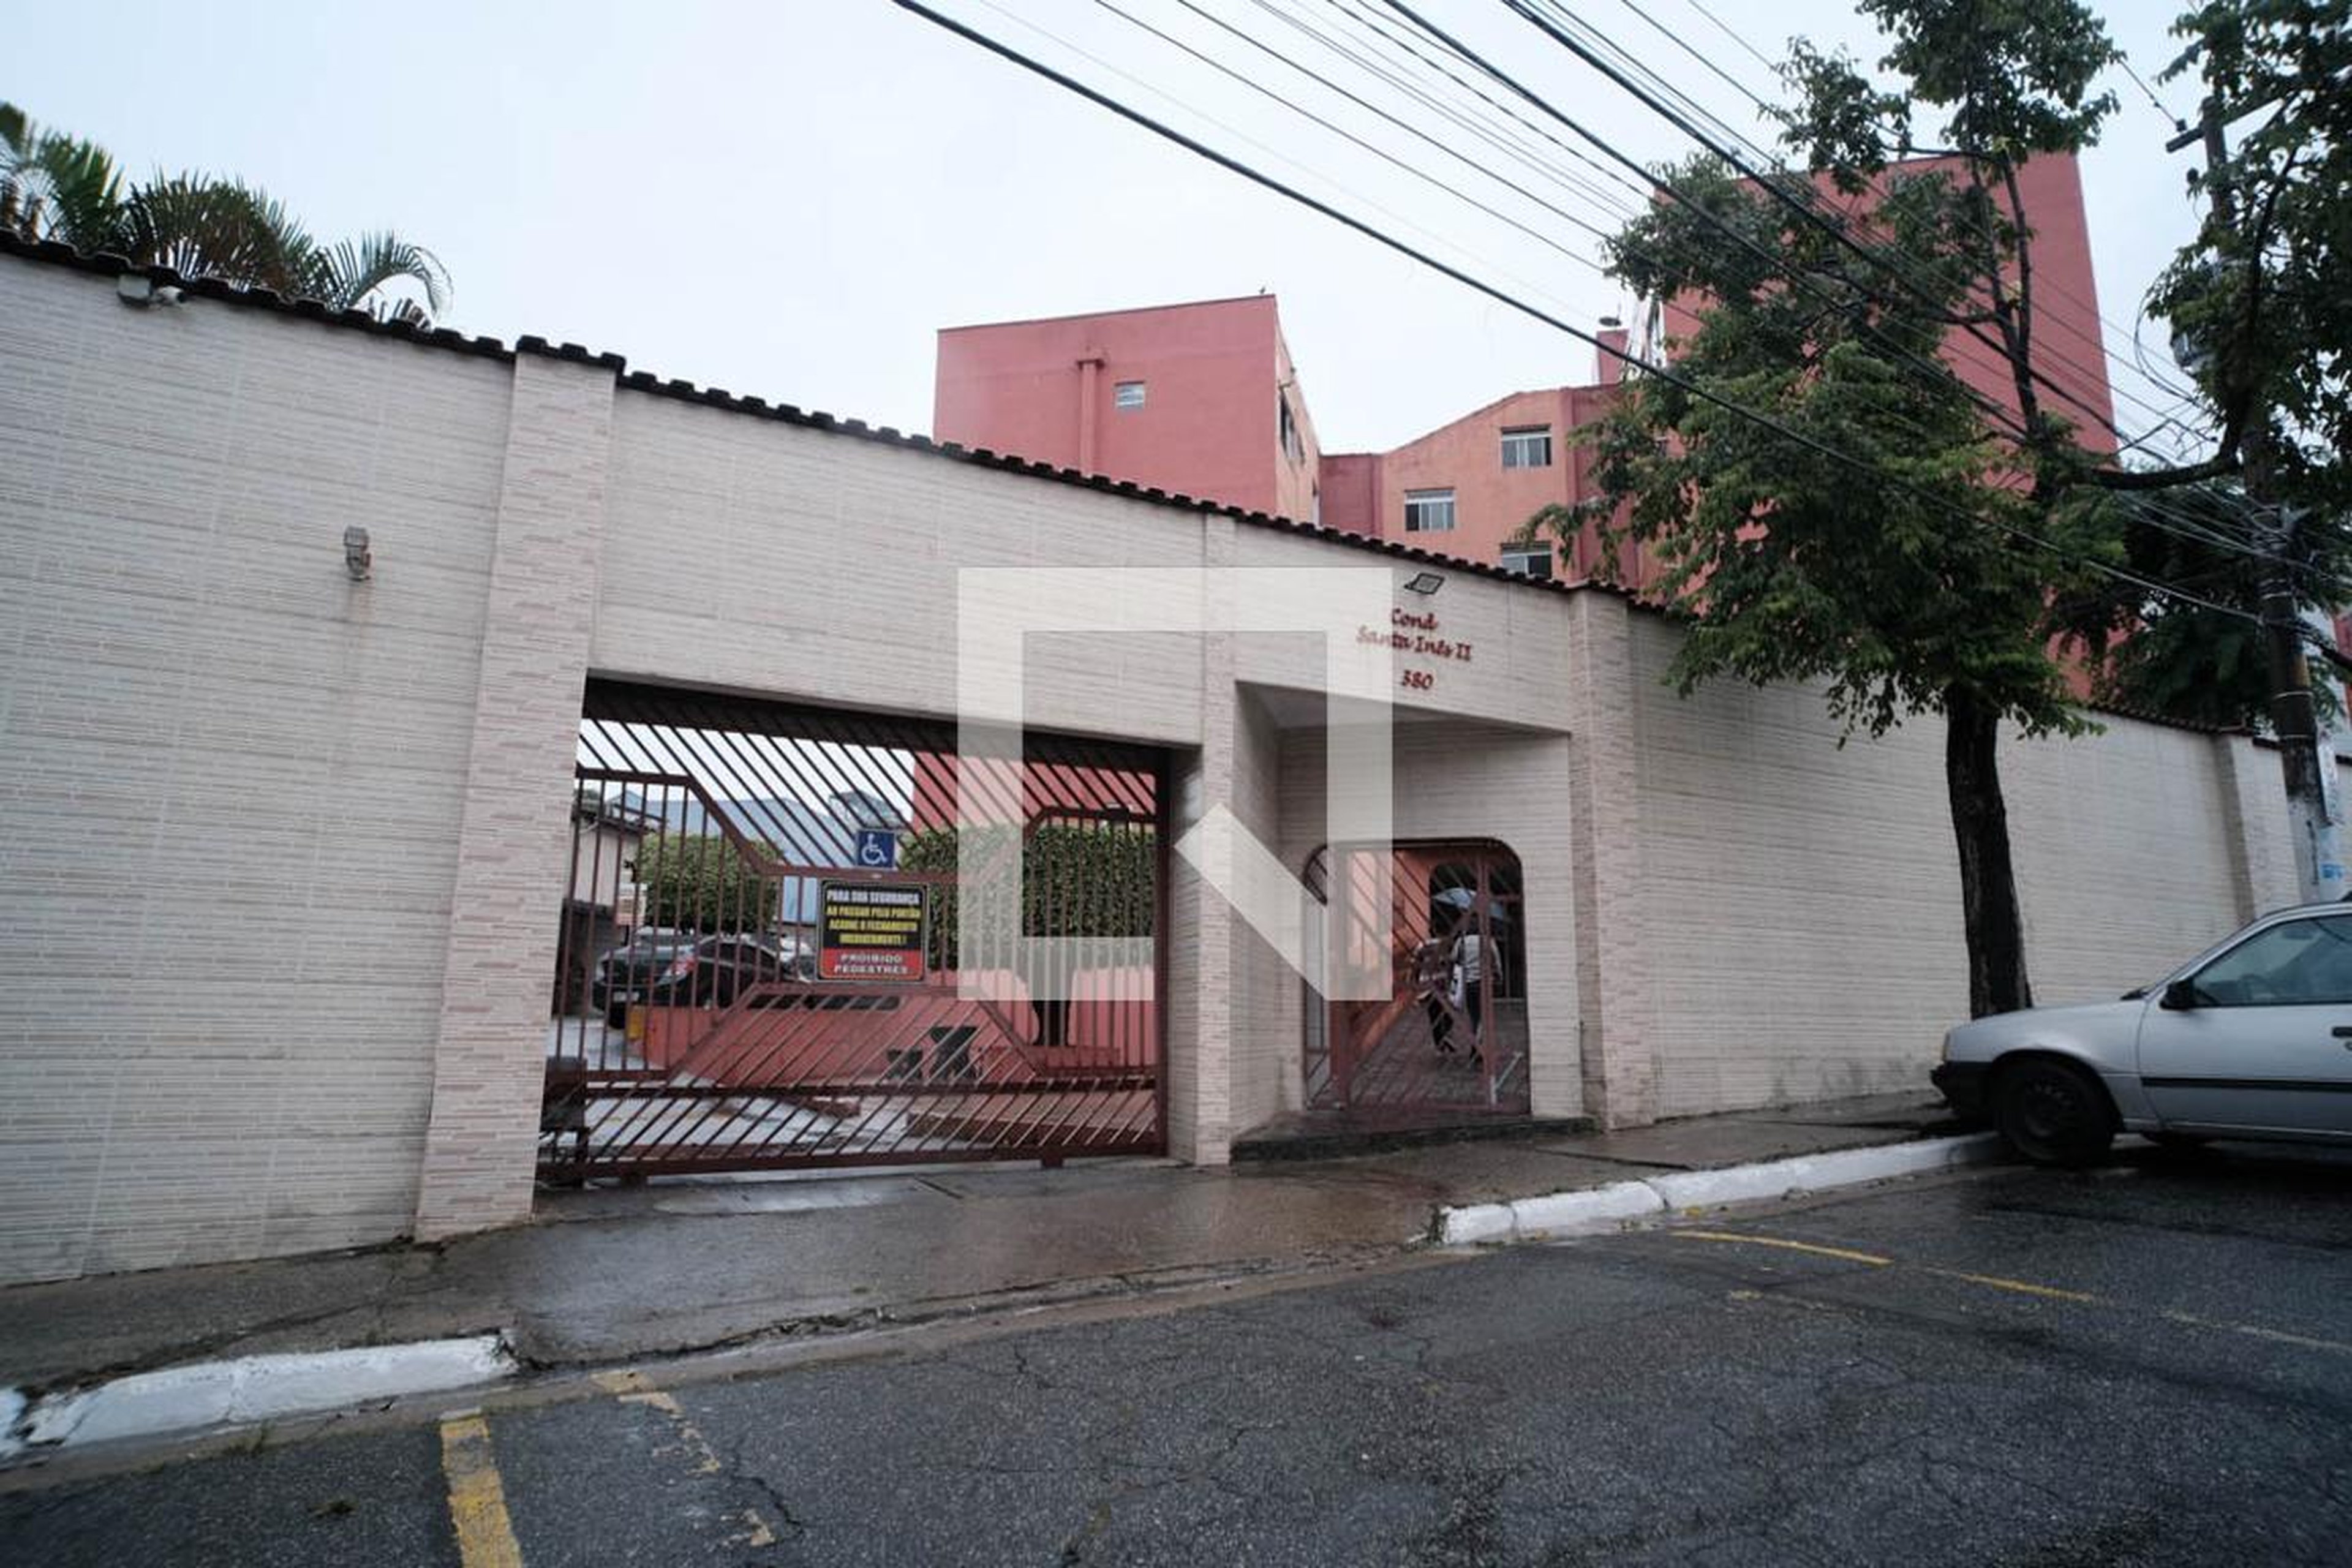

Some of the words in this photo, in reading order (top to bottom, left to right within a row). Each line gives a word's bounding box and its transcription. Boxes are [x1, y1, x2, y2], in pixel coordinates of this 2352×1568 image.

[1355, 625, 1414, 650] Santa
[1456, 642, 1473, 662] II
[1401, 669, 1434, 690] 380
[827, 889, 850, 903] PARA
[851, 890, 869, 903] SUA
[870, 891, 920, 905] SEGURANÇA
[840, 954, 902, 964] PROIBIDO
[834, 965, 908, 974] PEDESTRES
